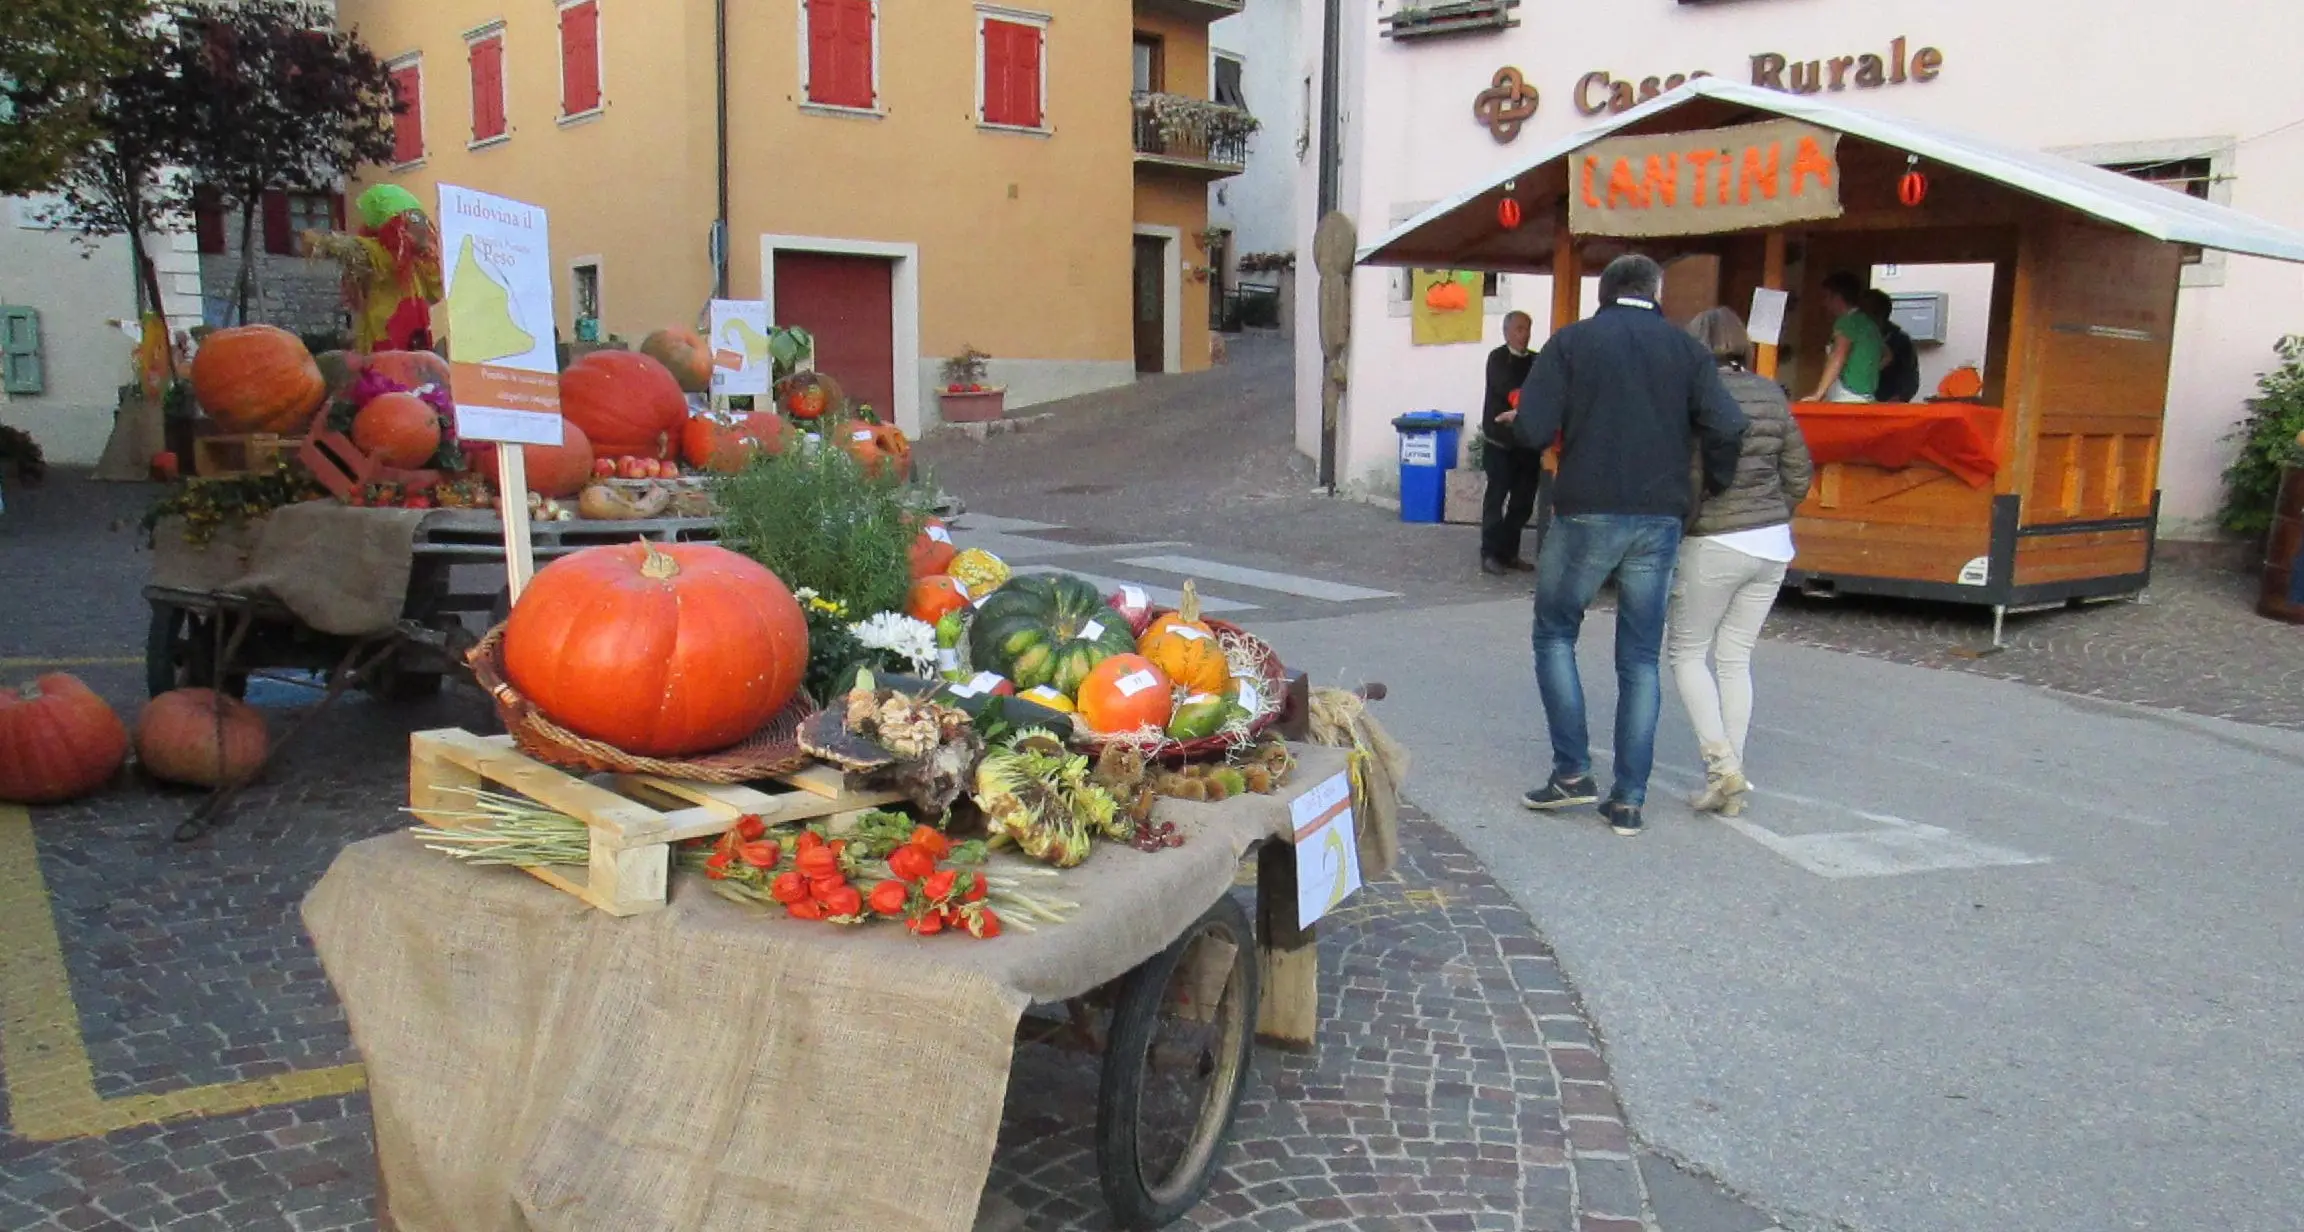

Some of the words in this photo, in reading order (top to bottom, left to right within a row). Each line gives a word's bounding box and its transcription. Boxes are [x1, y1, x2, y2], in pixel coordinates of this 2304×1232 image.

[1574, 69, 1715, 116] Cas
[1748, 35, 1943, 94] Rurale
[456, 194, 519, 226] Indovina
[524, 210, 532, 229] il
[483, 243, 516, 267] Peso
